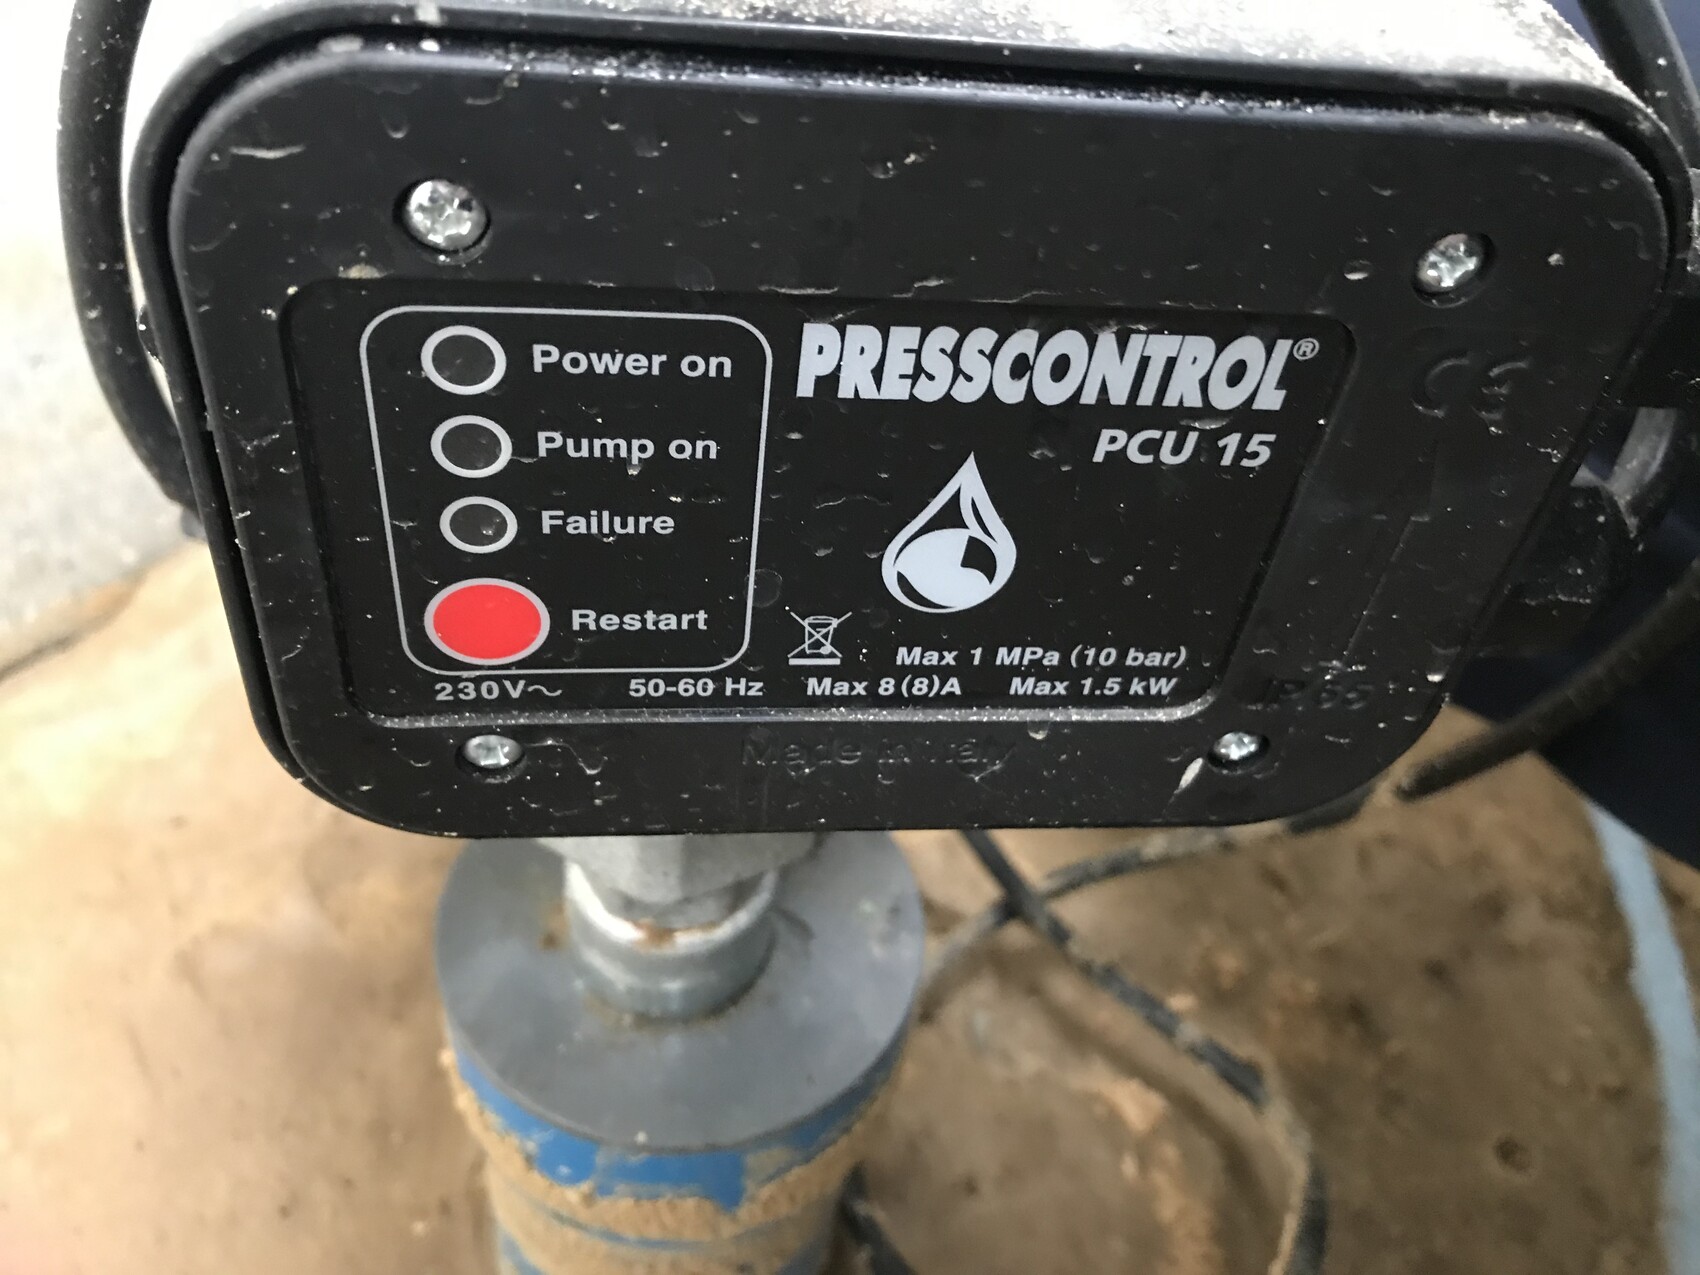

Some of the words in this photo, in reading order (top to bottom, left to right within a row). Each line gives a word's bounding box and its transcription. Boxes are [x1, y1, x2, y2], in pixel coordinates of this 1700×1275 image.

[532, 343, 667, 376] Power
[680, 354, 732, 378] on
[537, 431, 654, 464] Pump
[668, 438, 718, 460] on
[1092, 428, 1198, 465] PCU
[1216, 432, 1277, 468] 15
[541, 510, 675, 535] Failure
[572, 609, 708, 631] Restart
[896, 646, 958, 666] Max
[970, 646, 983, 666] 1
[995, 646, 1060, 666] MPa
[1070, 645, 1117, 668] (10
[1125, 646, 1187, 669] bar)
[629, 677, 714, 698] 50-60
[725, 676, 764, 697] Hz
[806, 677, 867, 696] Max
[1009, 677, 1069, 696] Max
[1081, 677, 1121, 696] 1.5
[1129, 677, 1178, 696] kW
